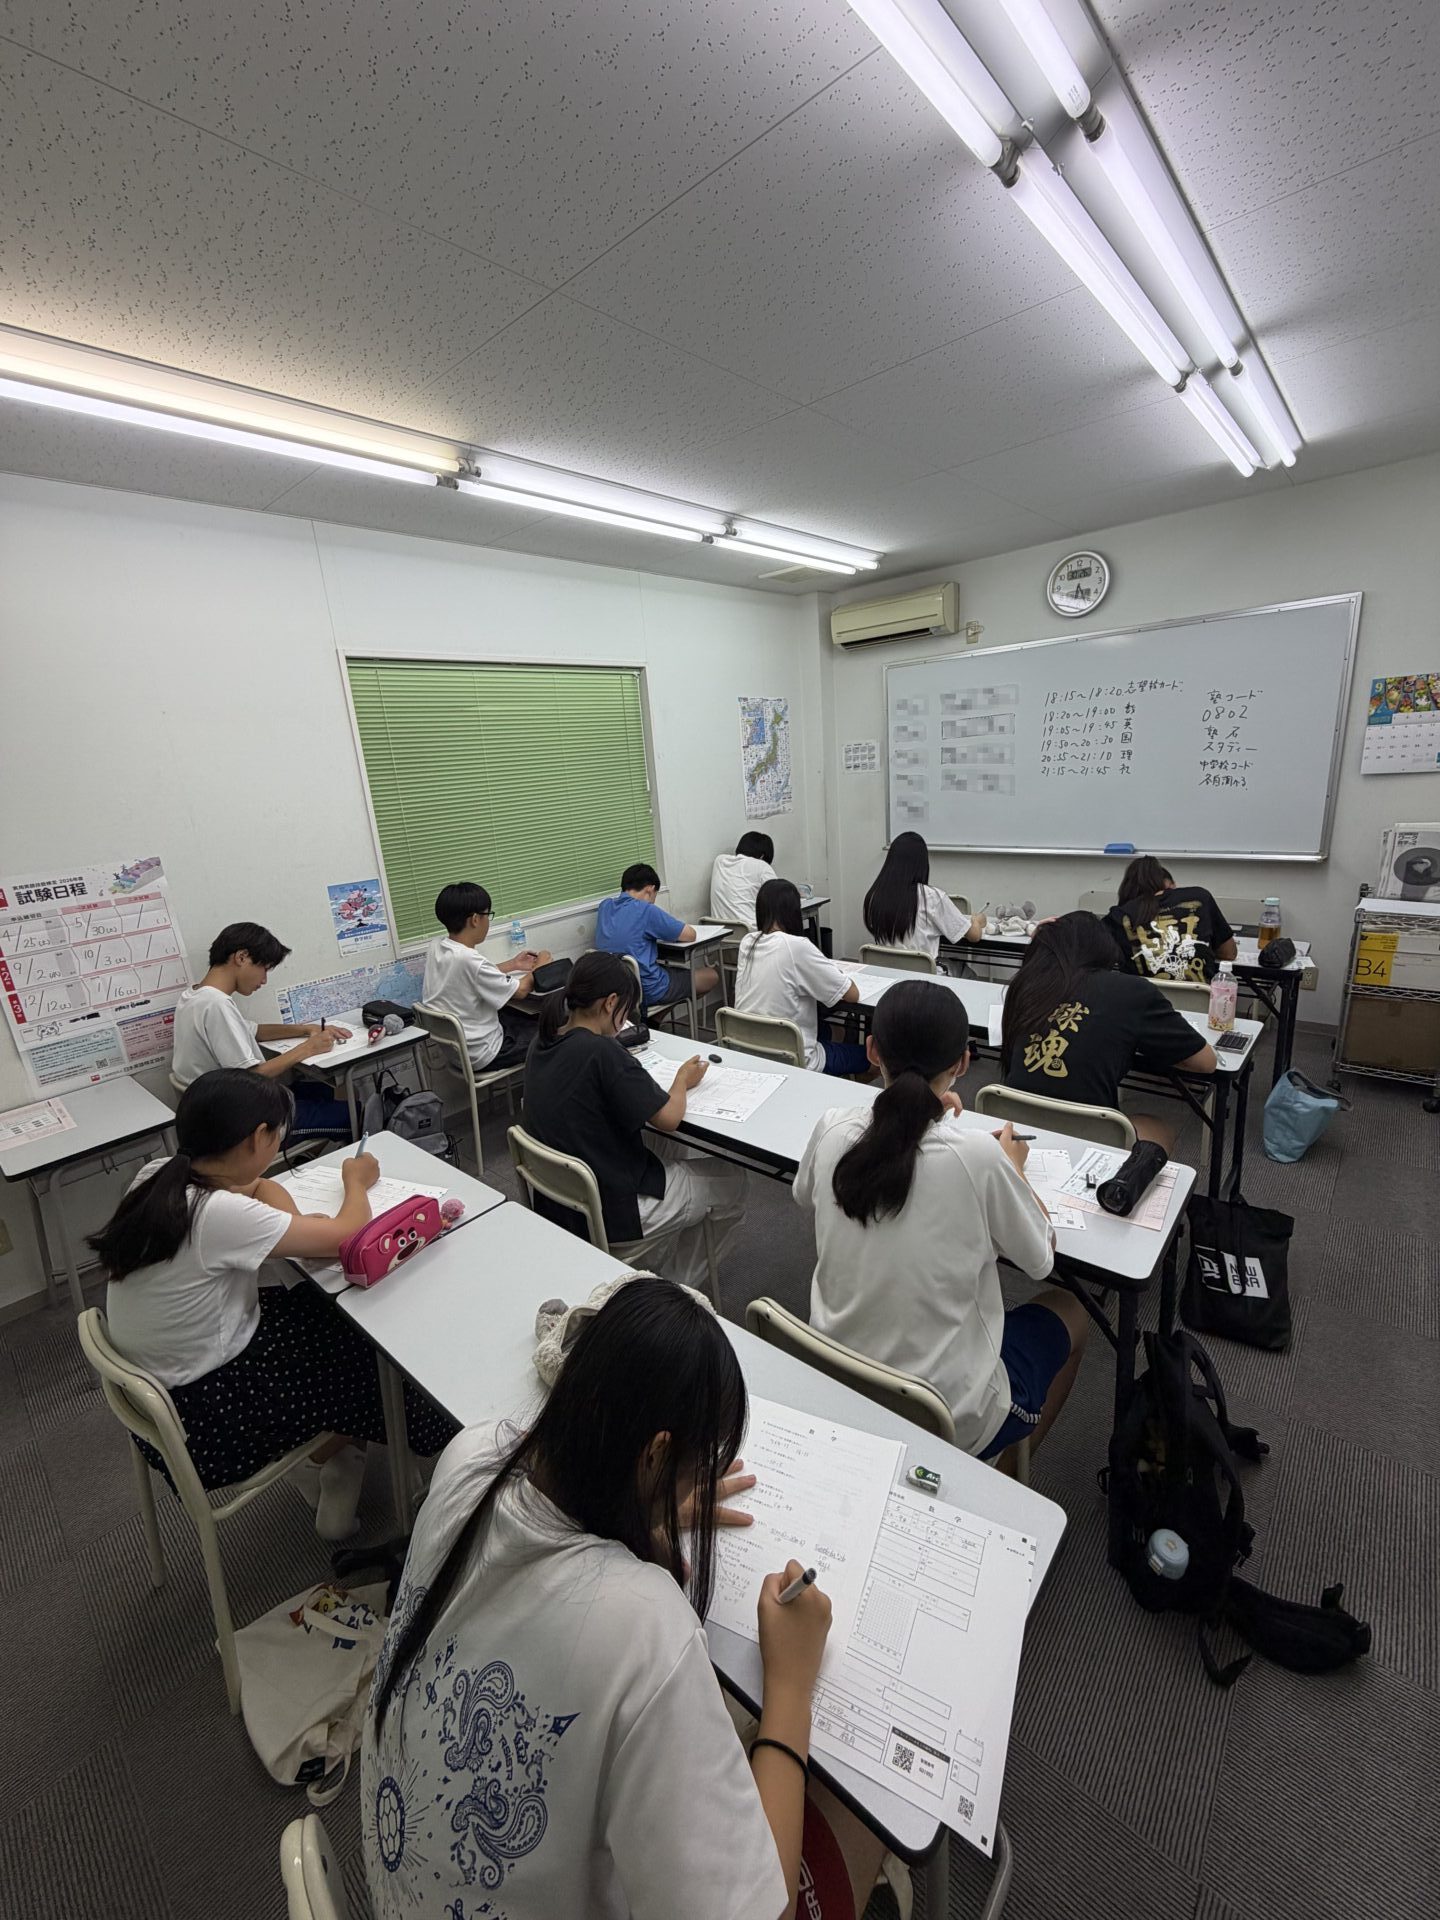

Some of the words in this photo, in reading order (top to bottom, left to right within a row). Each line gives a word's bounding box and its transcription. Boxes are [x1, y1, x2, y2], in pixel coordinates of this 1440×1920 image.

[1375, 682, 1383, 692] 9
[1202, 704, 1248, 722] 0802
[15, 882, 88, 905] 試験日程
[1355, 958, 1387, 978] B4
[1230, 1263, 1257, 1277] NW
